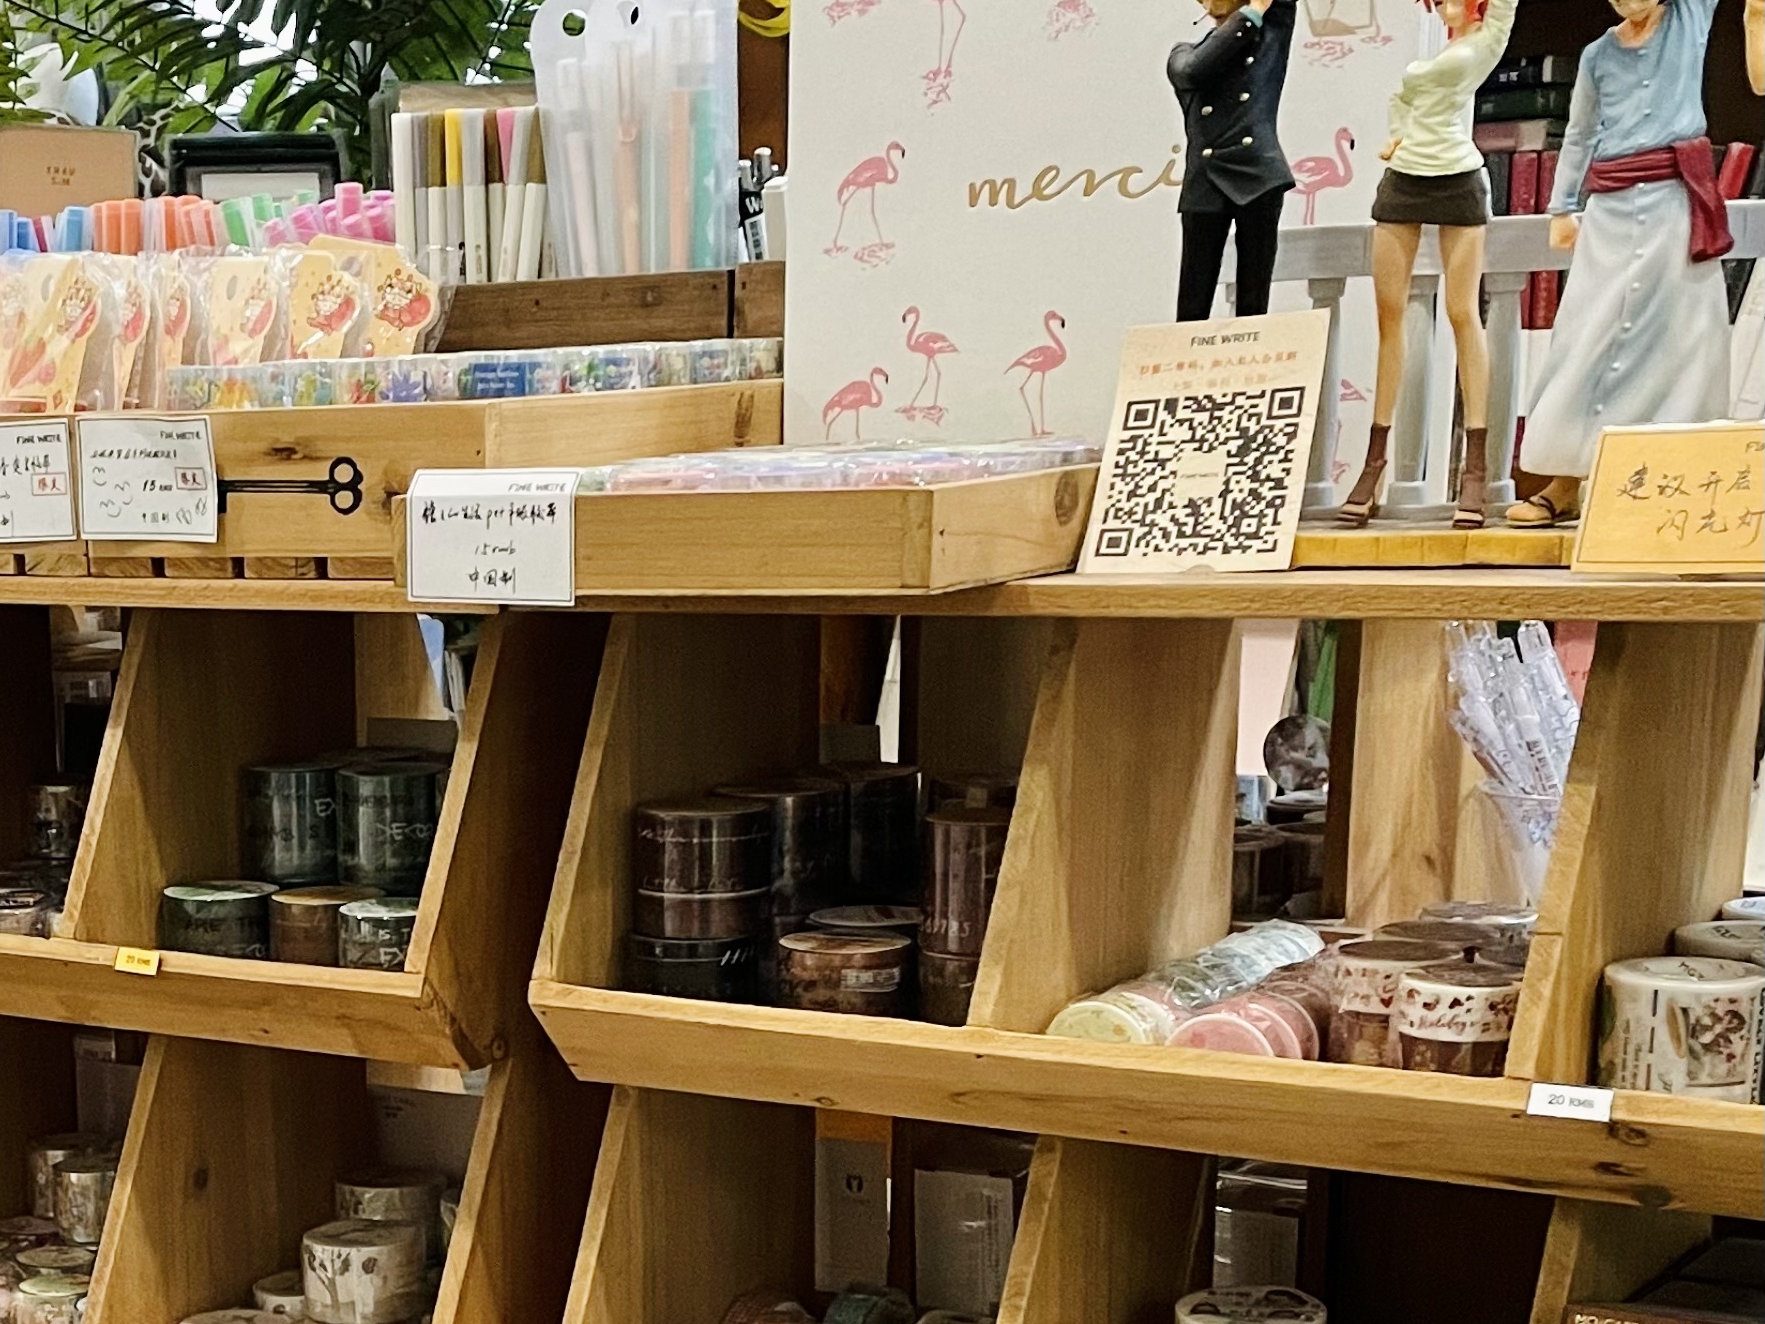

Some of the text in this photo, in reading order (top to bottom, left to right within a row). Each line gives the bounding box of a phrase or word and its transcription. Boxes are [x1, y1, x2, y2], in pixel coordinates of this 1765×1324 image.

[967, 143, 1184, 210] merci
[1190, 331, 1261, 348] FINE WRITE
[1547, 1094, 1565, 1106] 20
